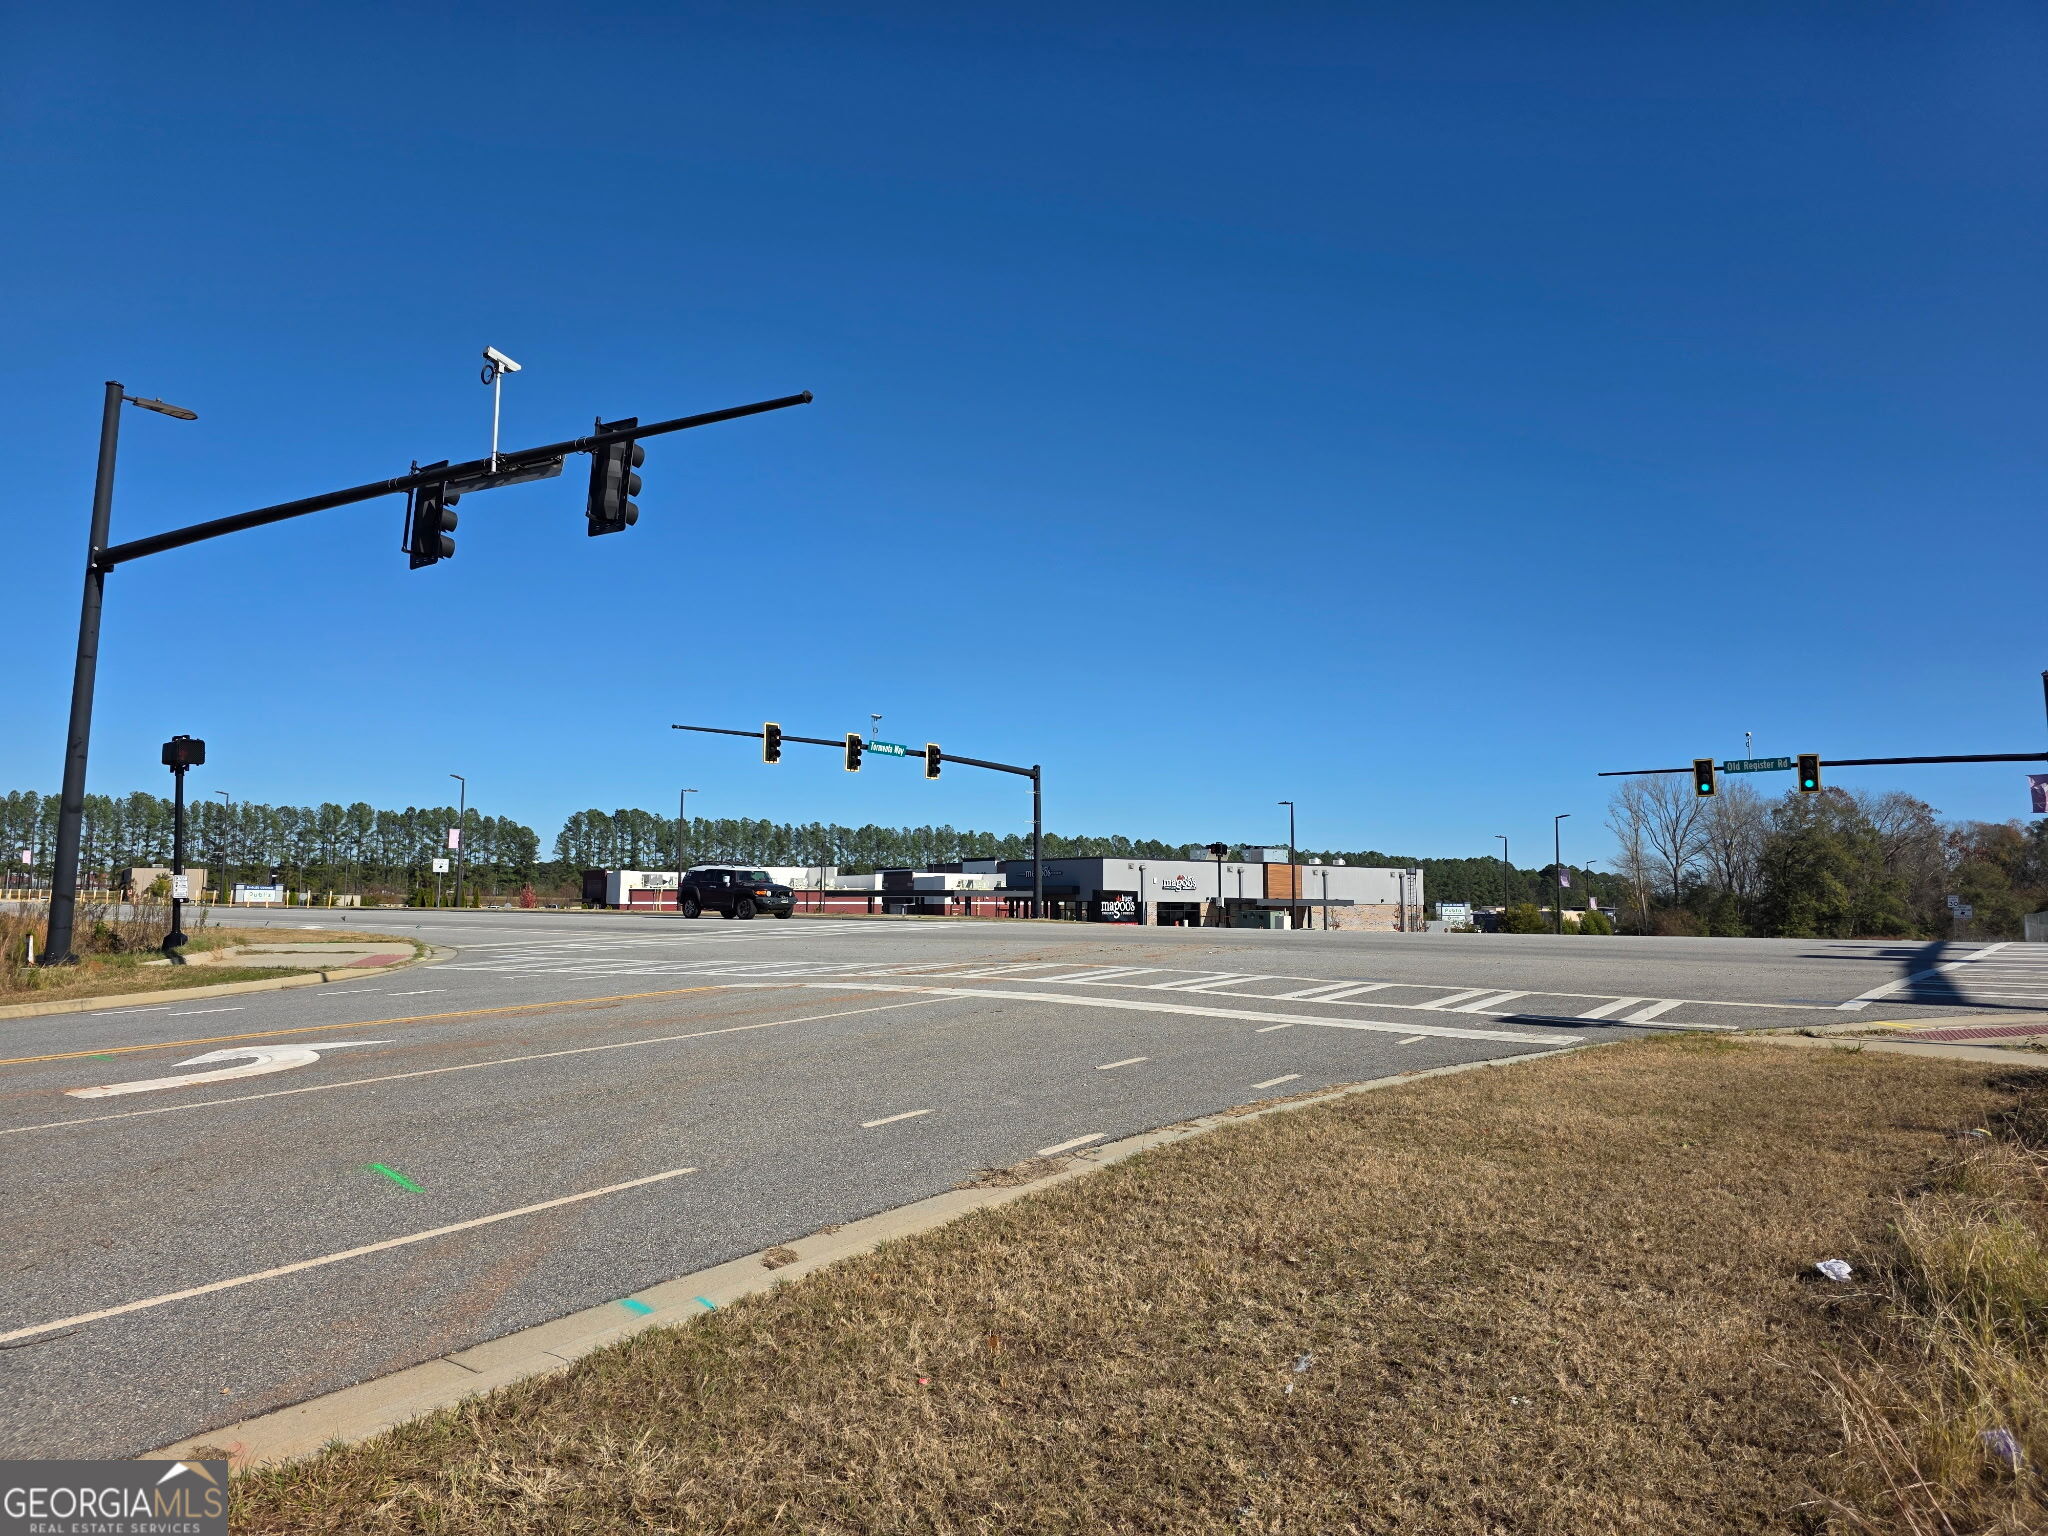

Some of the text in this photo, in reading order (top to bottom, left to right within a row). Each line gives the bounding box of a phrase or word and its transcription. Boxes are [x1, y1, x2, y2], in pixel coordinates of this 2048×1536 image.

[893, 744, 905, 757] Way
[1727, 758, 1788, 772] Old Register Rd
